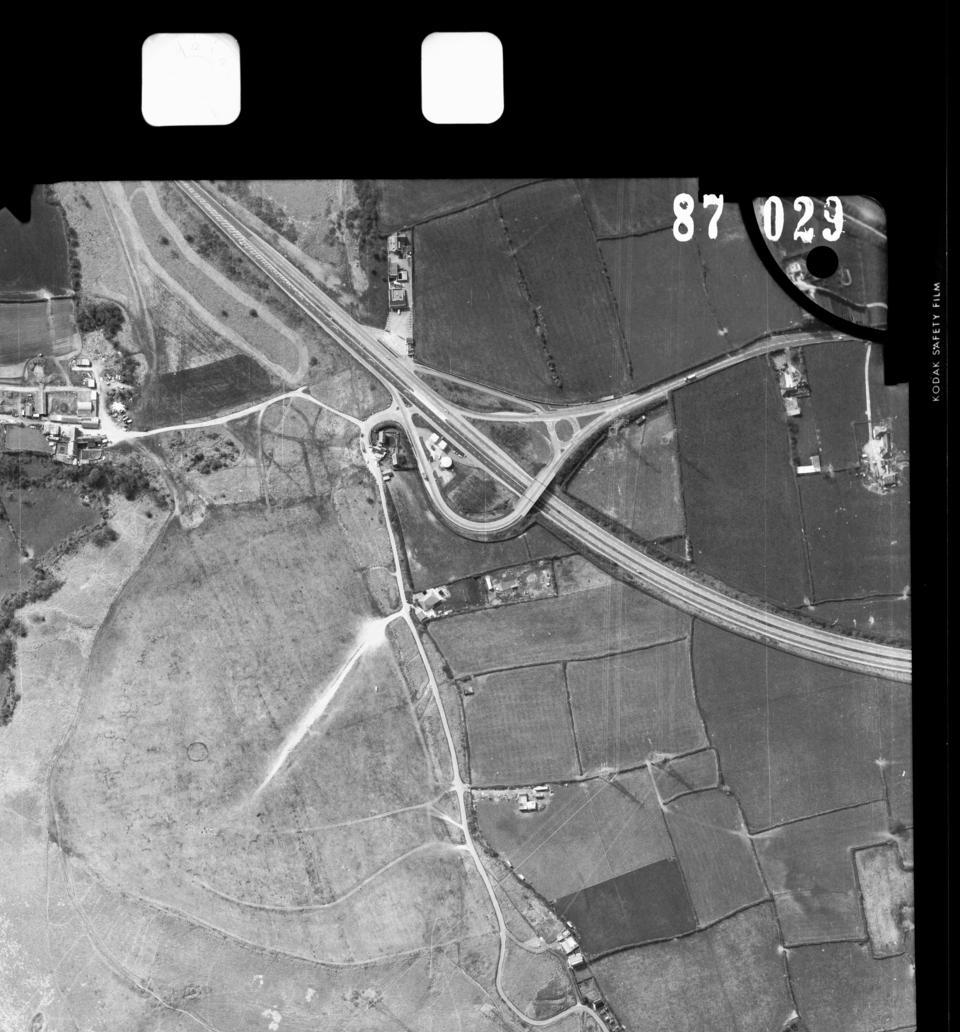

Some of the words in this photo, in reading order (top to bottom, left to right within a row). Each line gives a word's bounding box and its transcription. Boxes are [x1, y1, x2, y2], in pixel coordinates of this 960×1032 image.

[673, 193, 724, 242] 87
[763, 195, 845, 243] 029
[932, 282, 941, 308] FILM
[932, 314, 941, 356] SAFETY
[932, 361, 941, 402] KODAK
